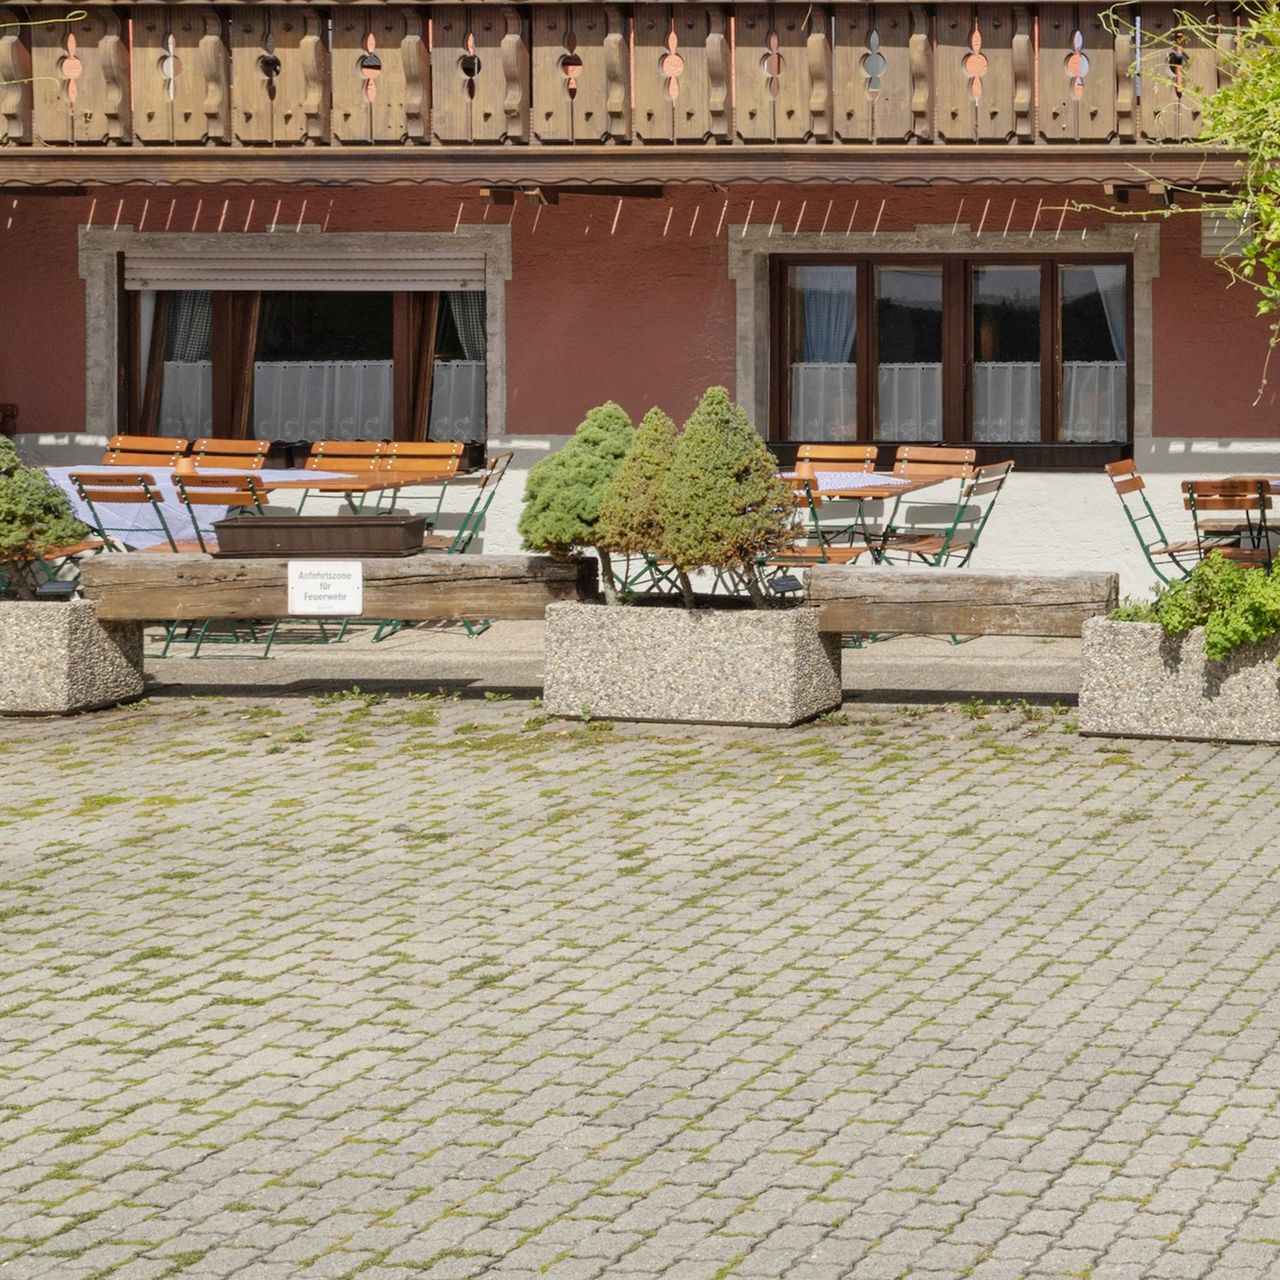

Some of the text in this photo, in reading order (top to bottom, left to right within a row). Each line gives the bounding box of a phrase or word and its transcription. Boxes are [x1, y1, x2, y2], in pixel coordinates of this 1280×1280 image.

[298, 571, 352, 580] Anfahrtszone
[319, 581, 332, 591] für
[303, 592, 348, 601] Feuerwehr
